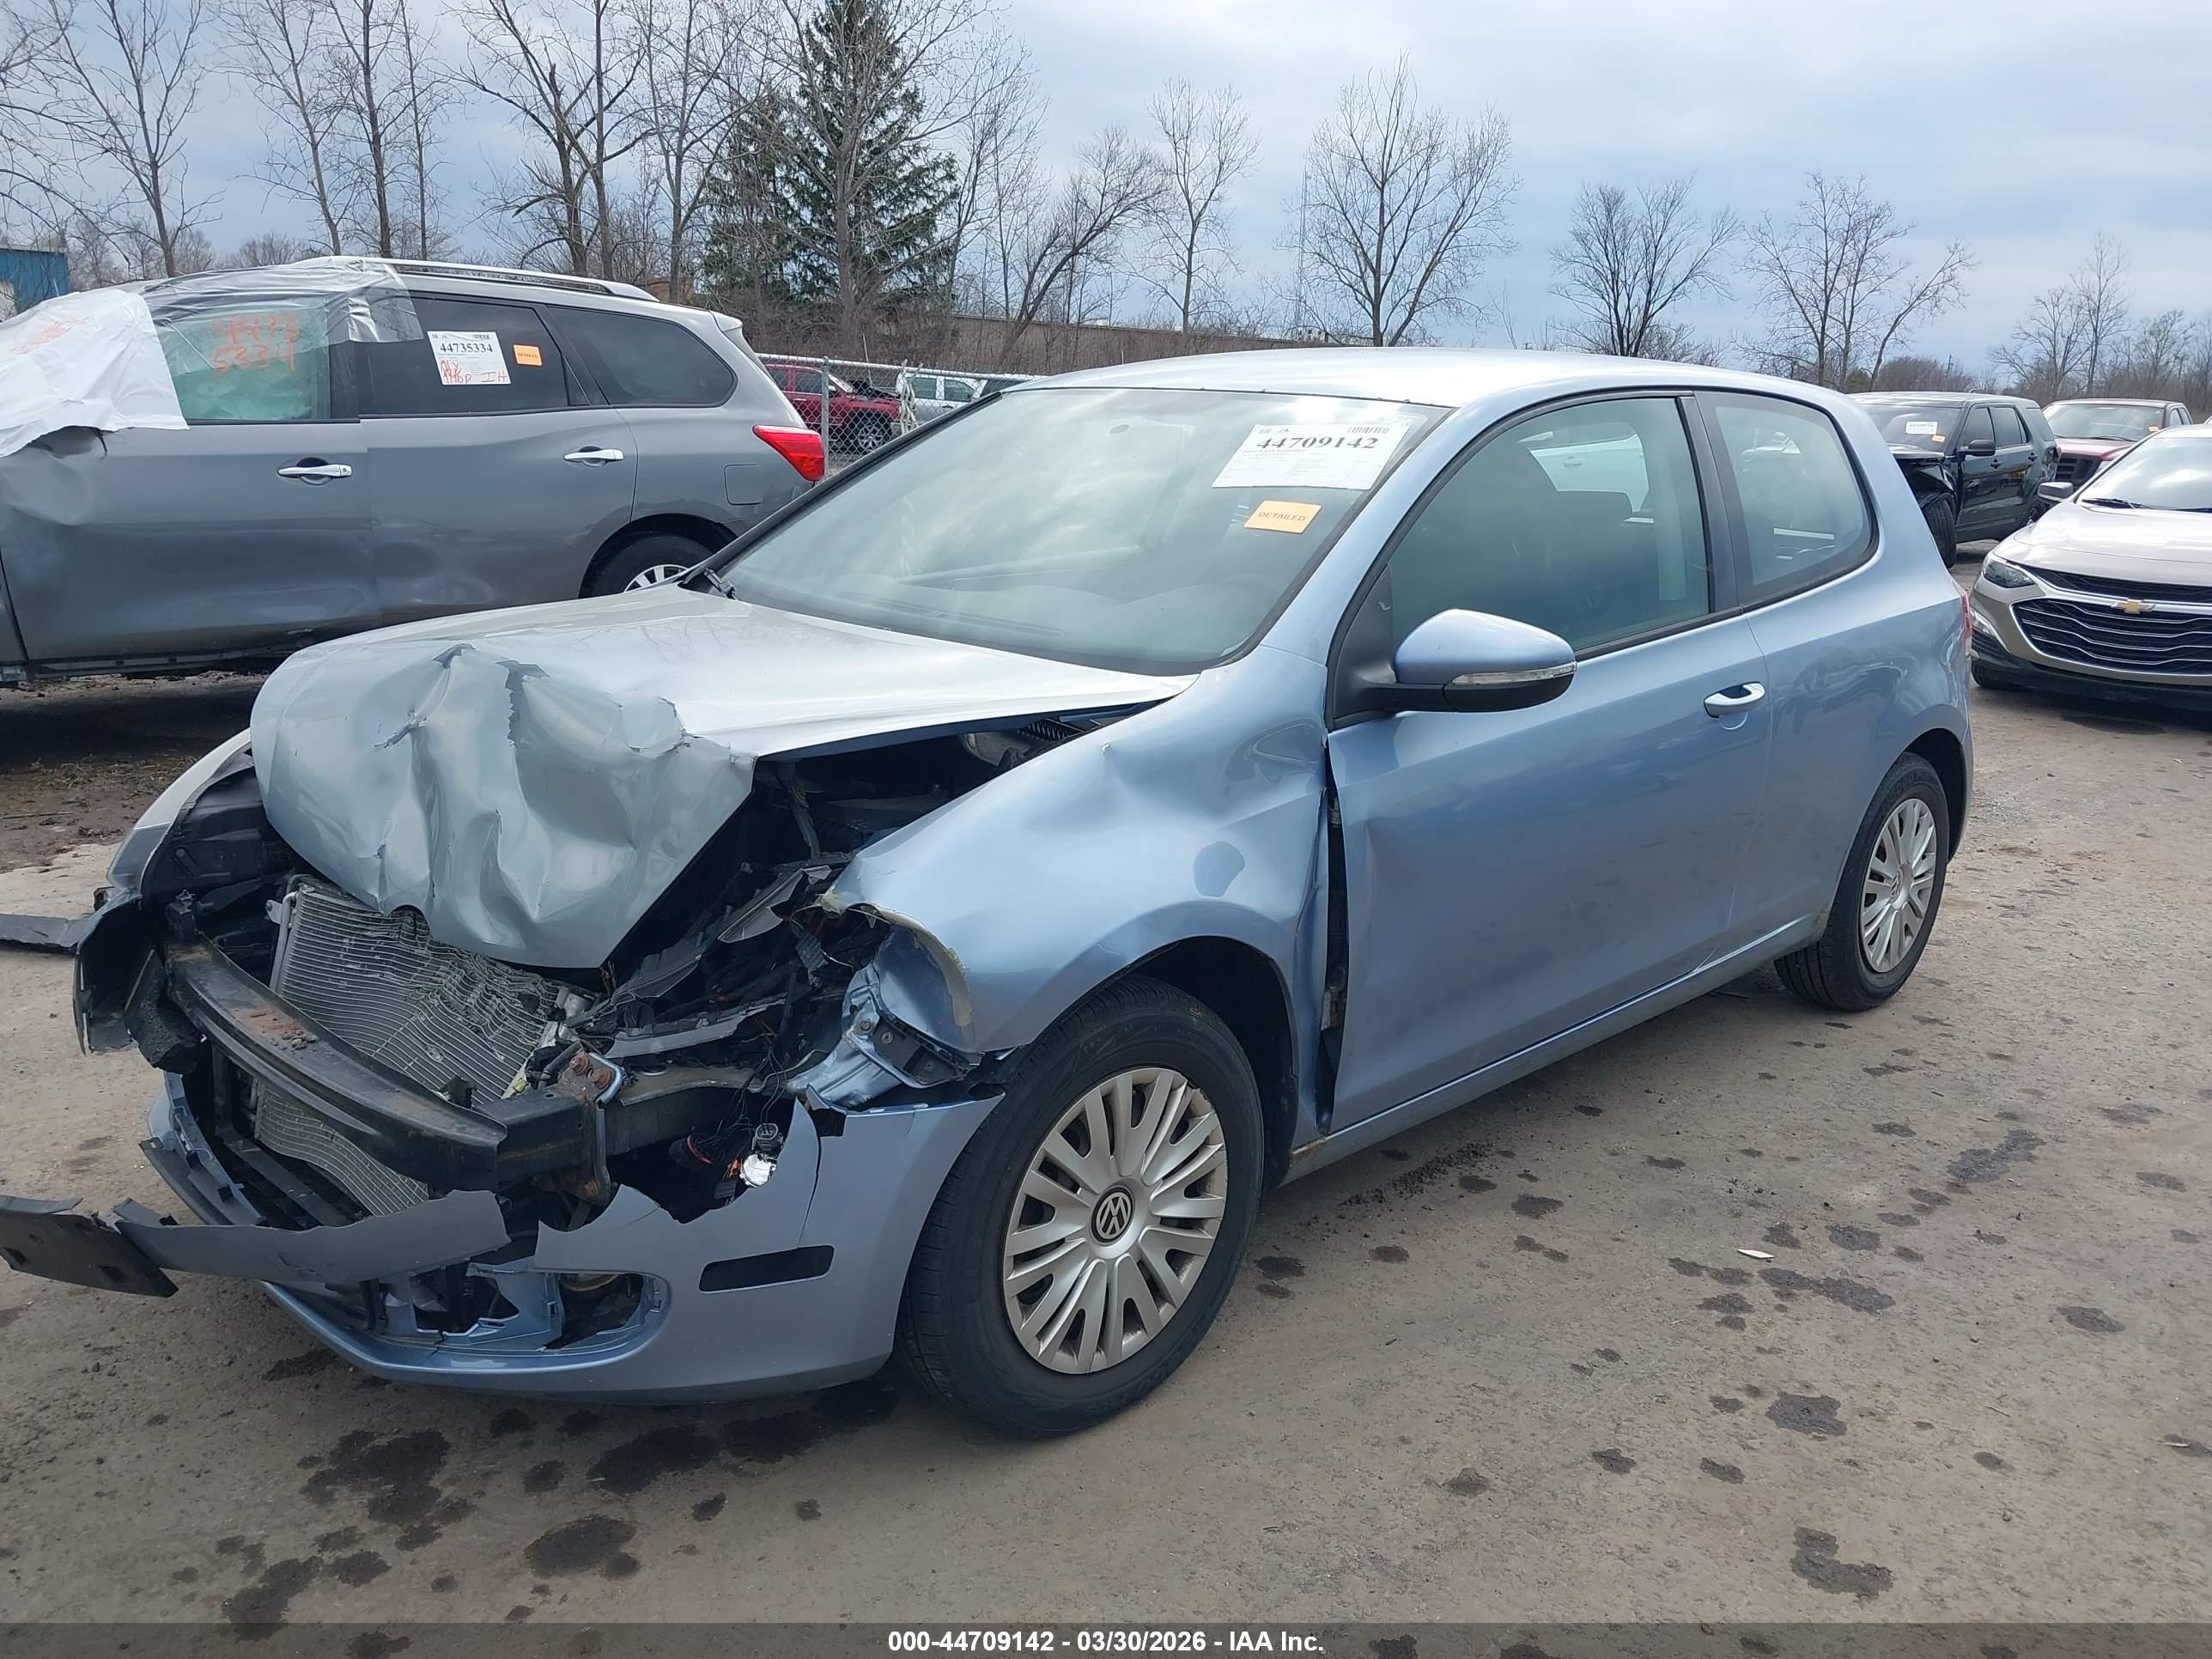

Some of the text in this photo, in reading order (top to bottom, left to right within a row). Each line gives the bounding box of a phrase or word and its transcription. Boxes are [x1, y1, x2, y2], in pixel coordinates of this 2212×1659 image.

[439, 343, 494, 353] 44735334
[1256, 436, 1379, 449] 44709142
[1257, 511, 1306, 521] DETAILED
